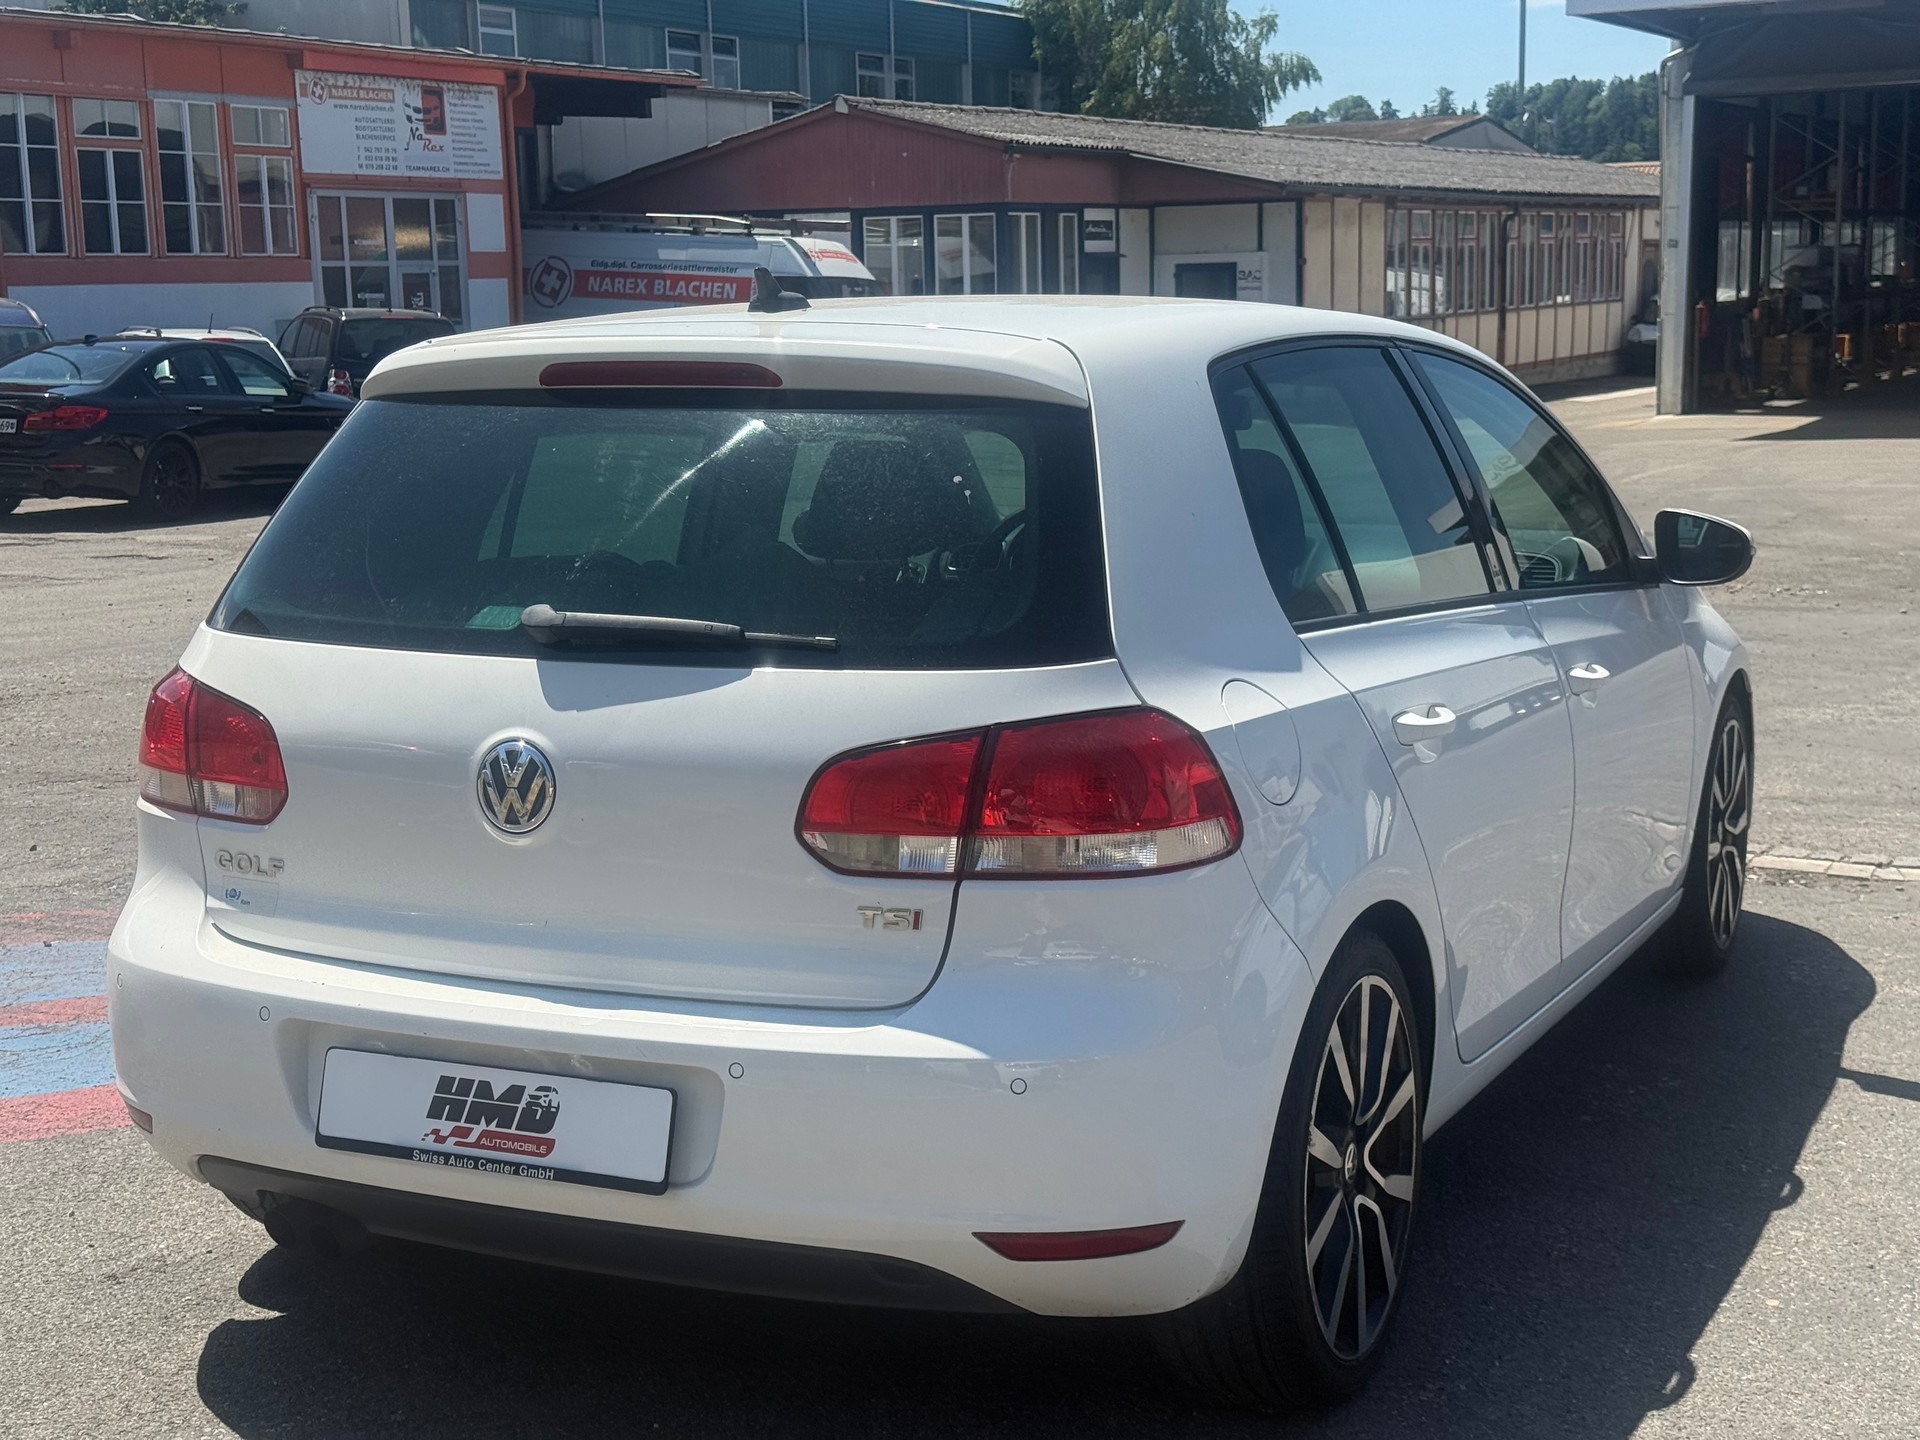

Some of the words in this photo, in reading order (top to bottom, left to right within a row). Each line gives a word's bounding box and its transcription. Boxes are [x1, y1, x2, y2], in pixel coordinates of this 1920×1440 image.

[331, 88, 358, 98] NAREX
[360, 89, 394, 100] BLACHEN
[333, 103, 395, 112] www.narexblachen.ch
[422, 138, 445, 152] Rex
[630, 261, 738, 274] Carrosseriesattlermeister
[587, 276, 648, 295] NAREX
[653, 279, 737, 299] BLACHEN
[214, 849, 285, 878] GOLF
[857, 905, 923, 931] TSI
[479, 1137, 548, 1154] AUTOMOBILE
[412, 1150, 445, 1165] Swiss
[448, 1155, 475, 1169] Auto
[478, 1159, 516, 1175] Center
[519, 1164, 555, 1180] GmbH
